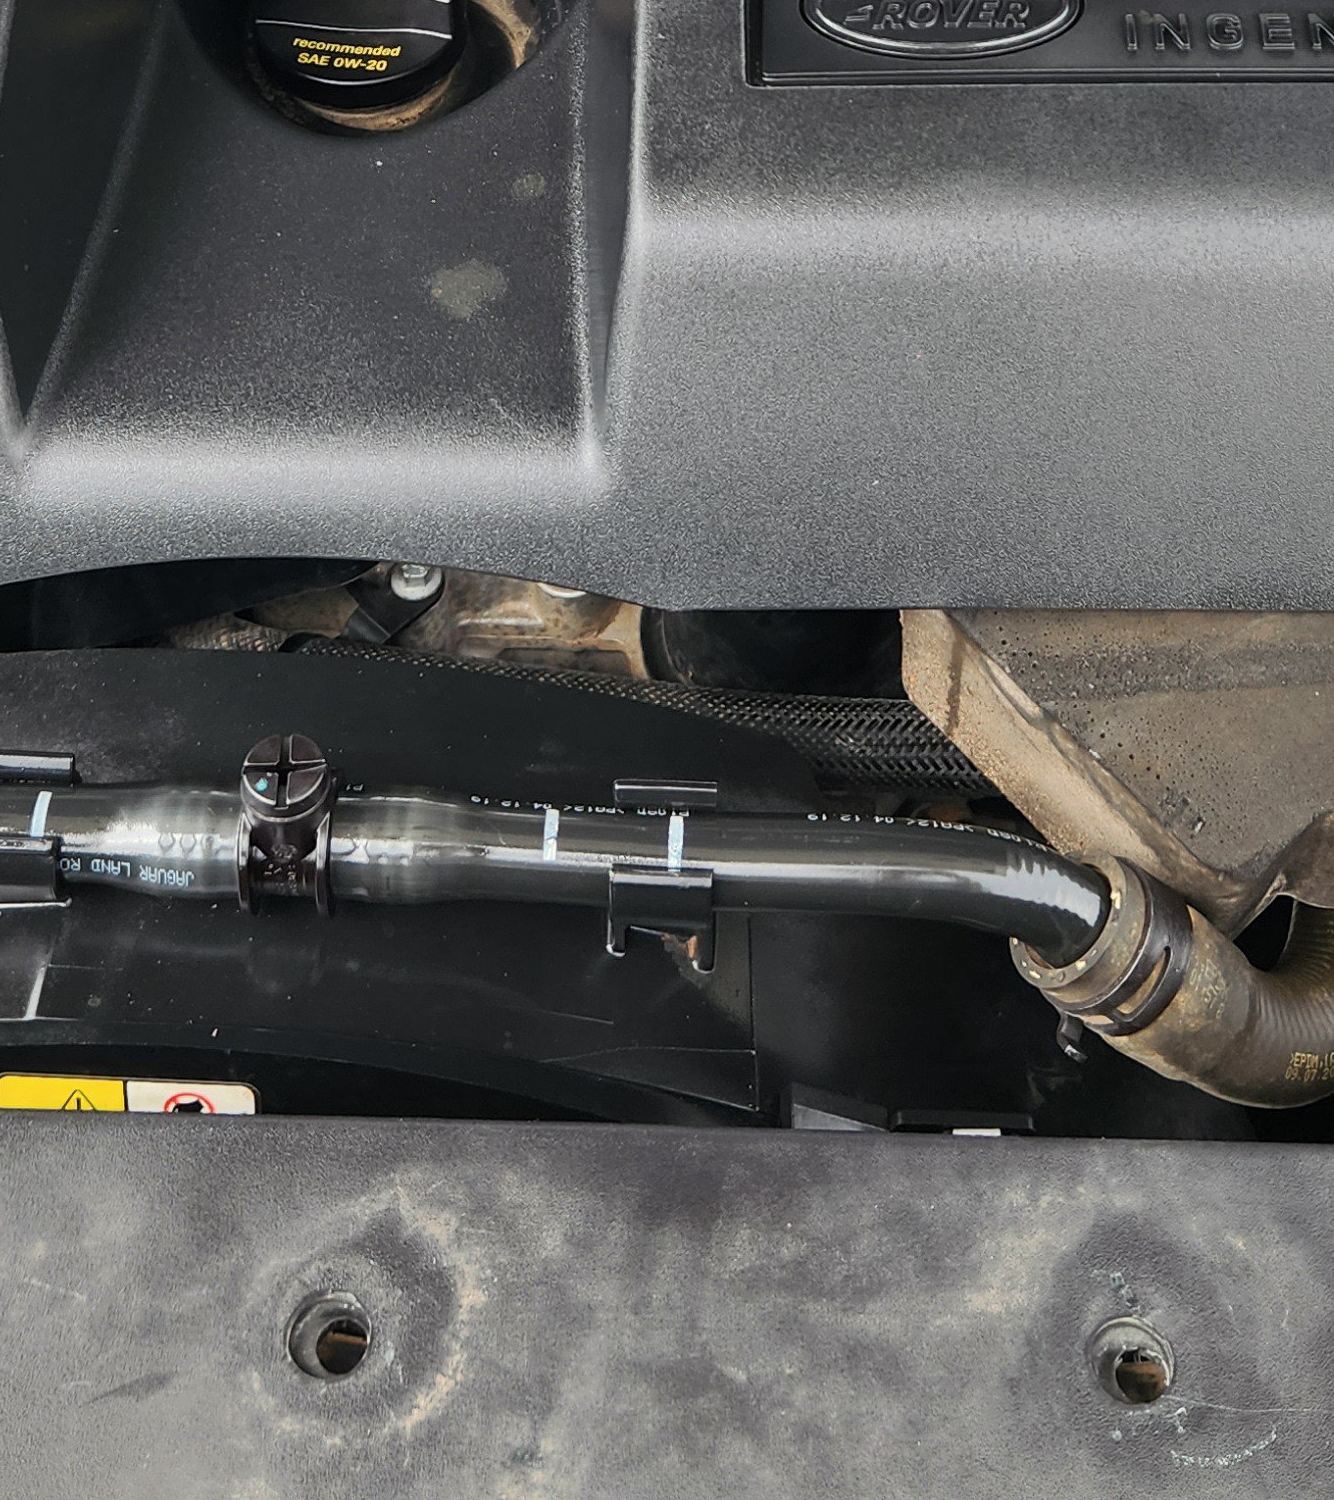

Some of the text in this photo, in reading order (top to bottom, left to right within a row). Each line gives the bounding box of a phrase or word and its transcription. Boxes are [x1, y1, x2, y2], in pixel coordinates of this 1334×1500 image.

[293, 38, 402, 57] recommended
[297, 52, 388, 71] SAE 0W-20
[91, 858, 131, 878] LAND
[139, 864, 195, 887] JAGUAR
